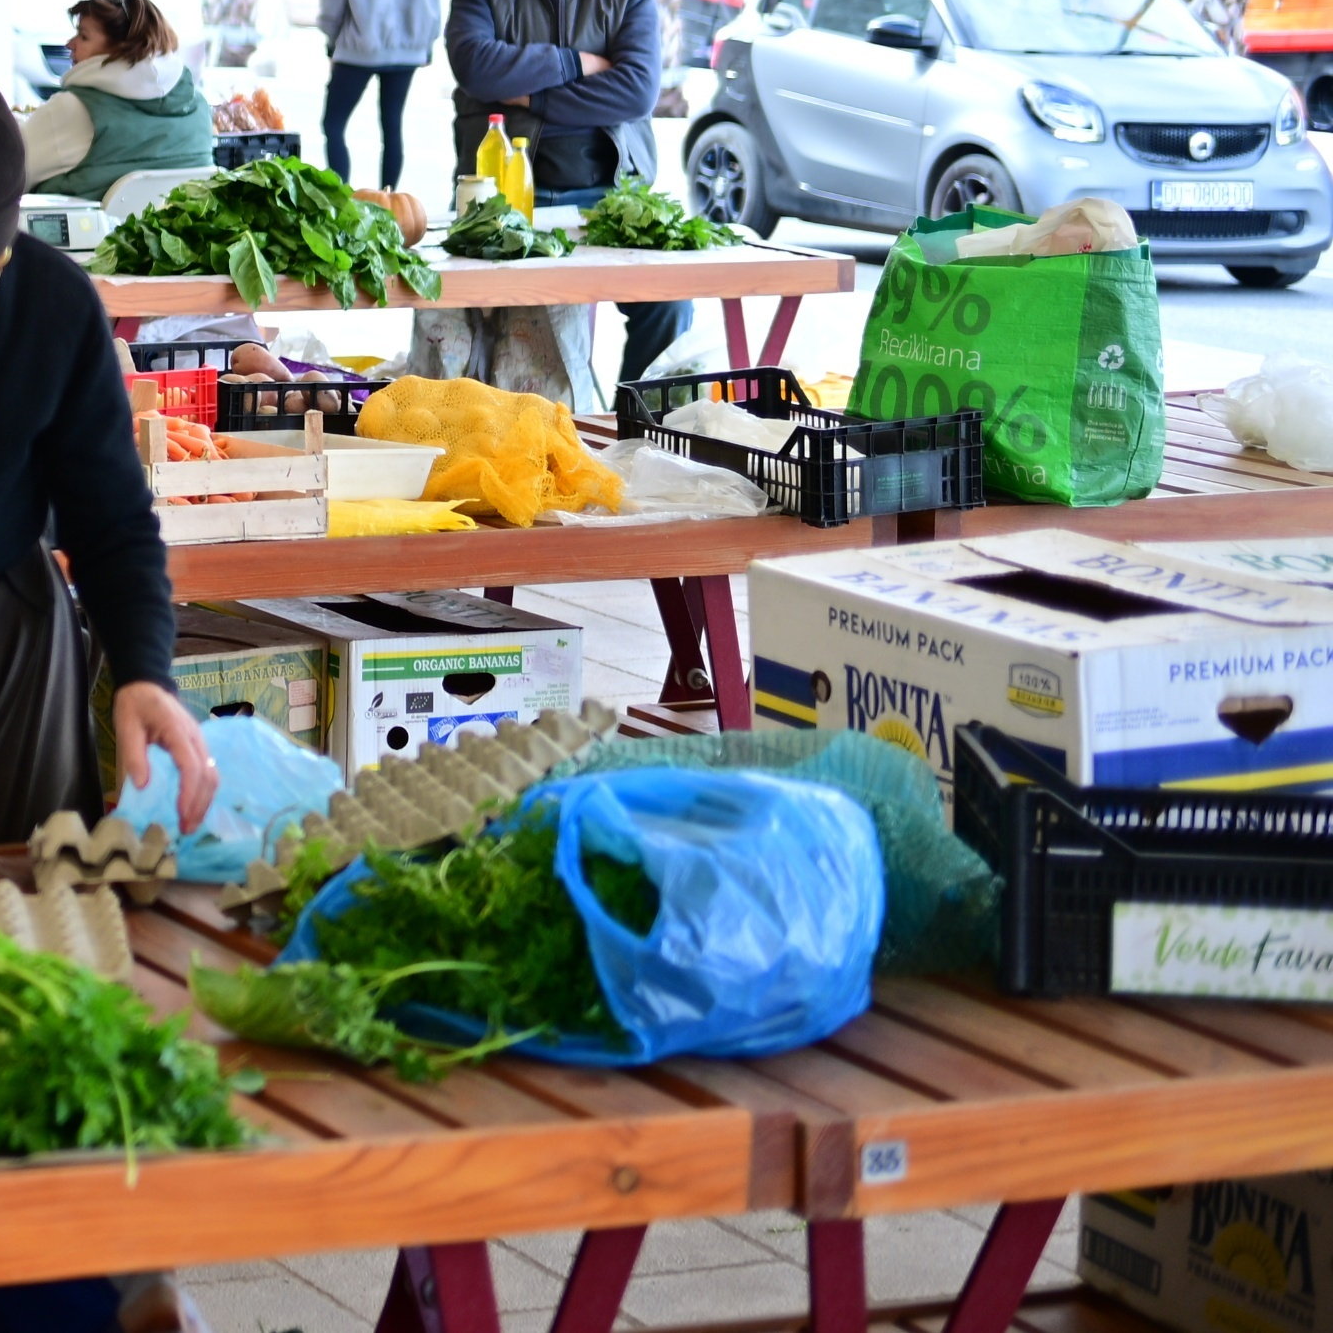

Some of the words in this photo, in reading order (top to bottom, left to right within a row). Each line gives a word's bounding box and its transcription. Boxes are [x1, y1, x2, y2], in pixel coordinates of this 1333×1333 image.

[879, 328, 982, 372] Reciklirana
[1070, 552, 1290, 612] BONITA
[1220, 554, 1333, 574] BO
[828, 606, 911, 650] PREMIUM
[917, 633, 966, 666] PACK
[175, 671, 230, 689] REMIUM
[235, 664, 295, 685] BANANAS
[413, 656, 466, 672] ORGANIC
[468, 654, 521, 670] BANANAS
[1169, 653, 1275, 684] PREMIUM
[843, 663, 952, 772] BONITA
[1188, 1181, 1316, 1297] BONITA
